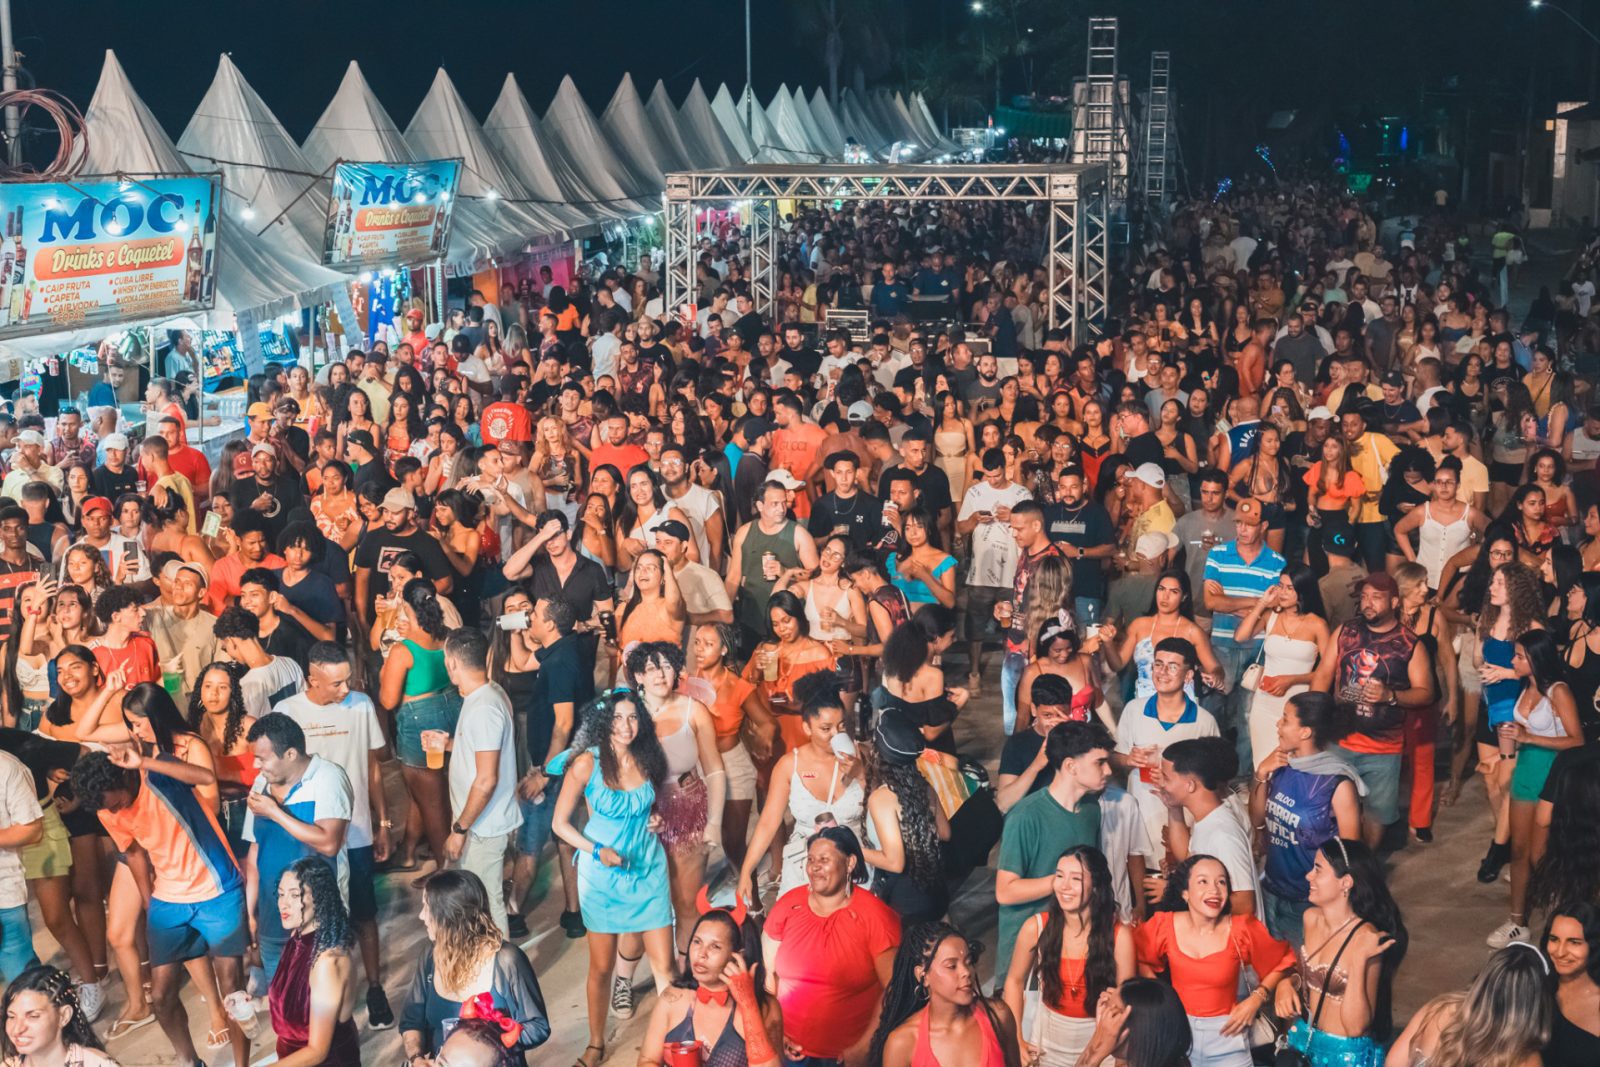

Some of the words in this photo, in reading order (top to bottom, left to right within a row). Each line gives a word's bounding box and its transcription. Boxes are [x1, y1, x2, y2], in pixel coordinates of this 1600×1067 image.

[360, 173, 440, 205] MOC
[37, 193, 185, 243] MOC
[365, 211, 394, 227] Drinks
[401, 208, 432, 227] Coquetel
[52, 246, 104, 273] Drinks
[107, 254, 115, 267] e
[117, 239, 175, 269] Coquetel
[46, 284, 65, 293] CAIP
[66, 280, 91, 291] FRUTA
[115, 276, 133, 286] CUBA
[135, 272, 154, 283] LIBRE
[50, 291, 81, 303] CAPETA
[1275, 792, 1295, 807] BLOCO
[1270, 836, 1289, 849] 2024
